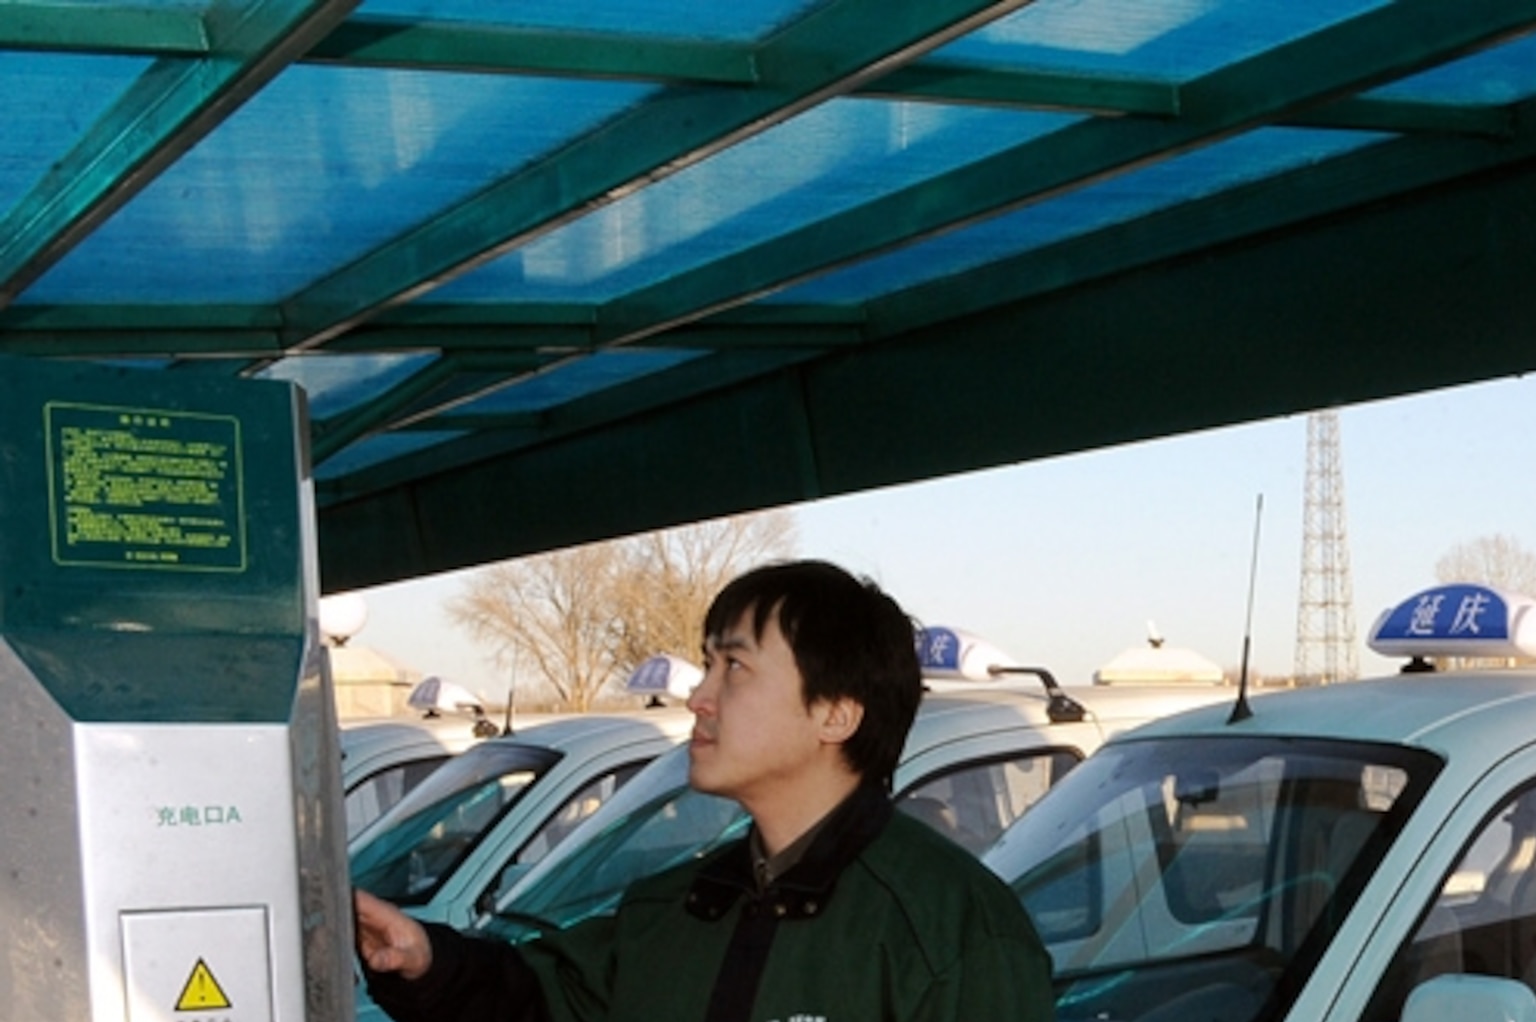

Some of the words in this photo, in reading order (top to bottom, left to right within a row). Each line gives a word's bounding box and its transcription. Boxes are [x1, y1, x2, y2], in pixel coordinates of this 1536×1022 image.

[1405, 592, 1491, 636] 延庆
[156, 804, 243, 827] 充电口A
